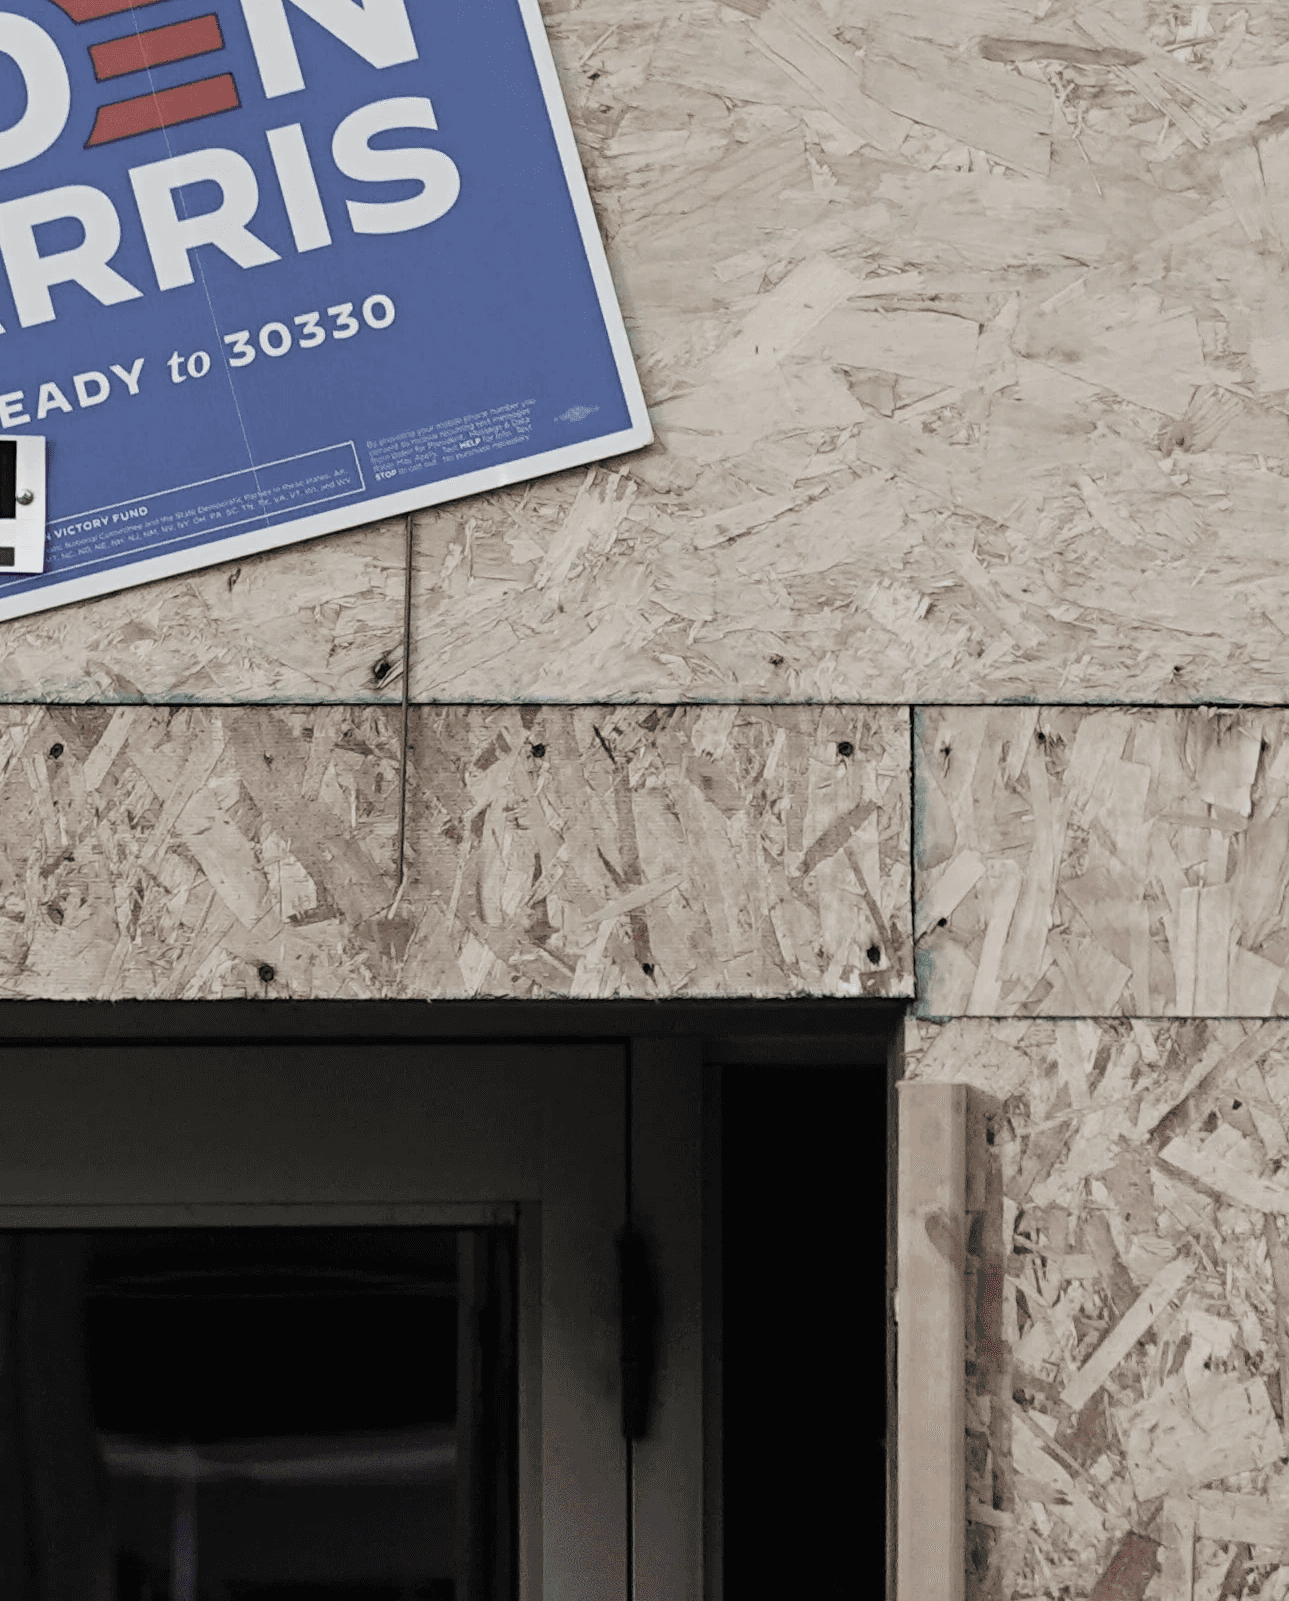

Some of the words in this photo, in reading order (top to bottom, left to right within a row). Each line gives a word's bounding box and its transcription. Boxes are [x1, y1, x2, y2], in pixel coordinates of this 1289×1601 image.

[167, 350, 212, 384] to
[223, 294, 396, 368] 30330
[53, 515, 110, 539] VICTORY
[111, 505, 149, 524] FUND
